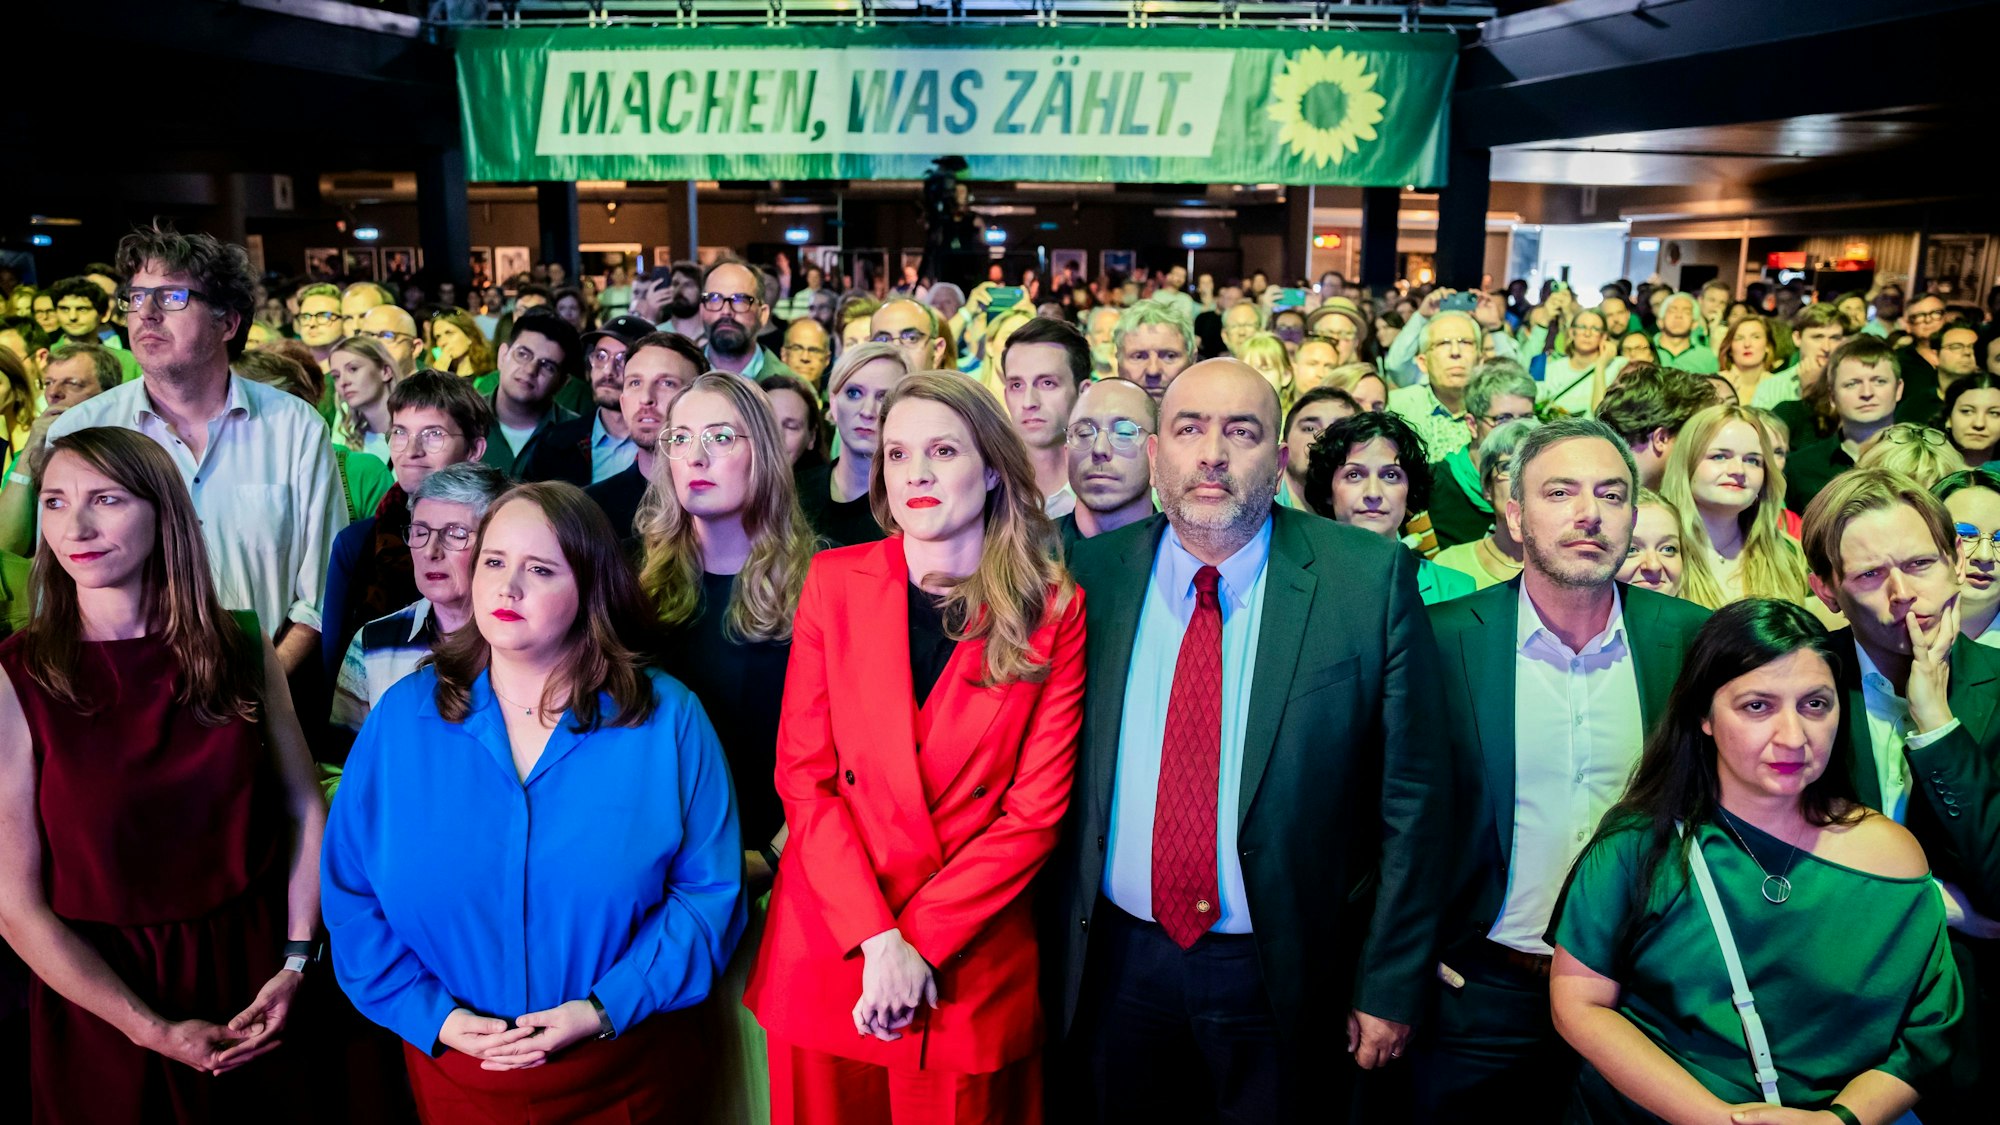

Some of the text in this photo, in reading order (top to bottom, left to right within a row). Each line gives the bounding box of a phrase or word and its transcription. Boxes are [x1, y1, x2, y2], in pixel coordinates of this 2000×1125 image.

[560, 54, 1193, 142] MACHEN, WAS ZÄHLT.
